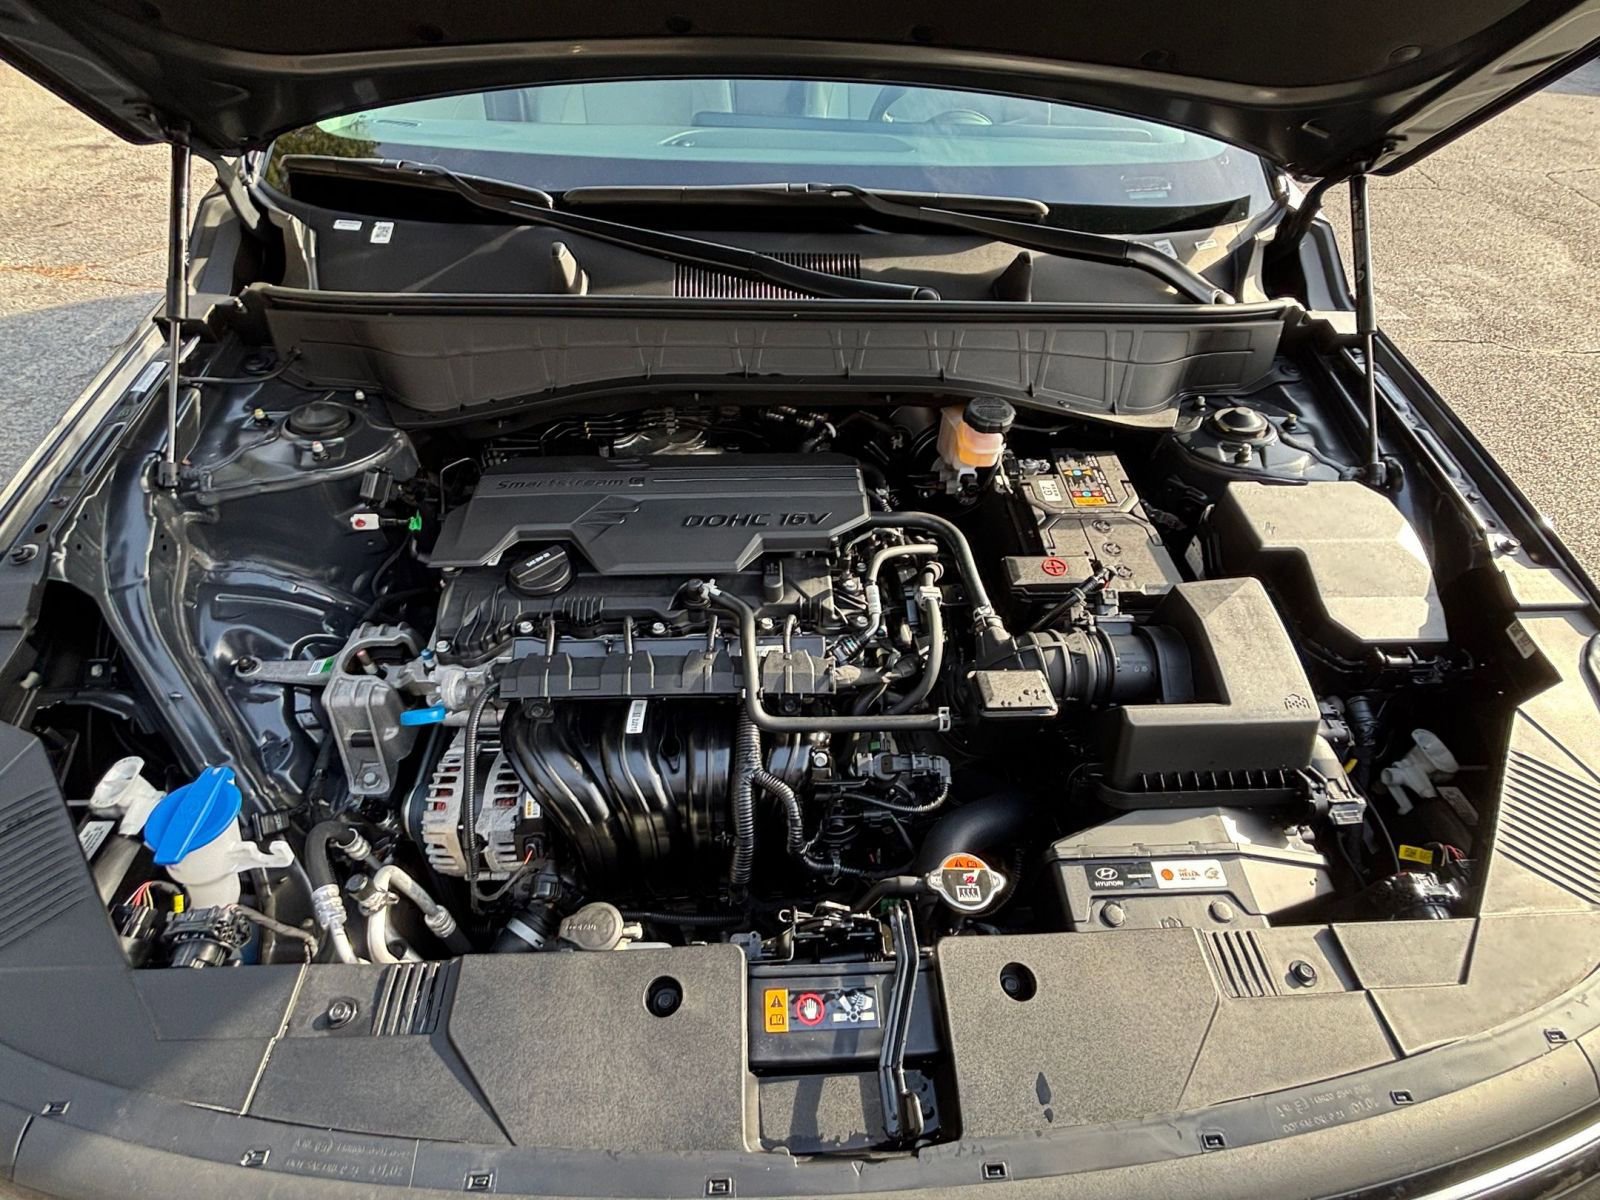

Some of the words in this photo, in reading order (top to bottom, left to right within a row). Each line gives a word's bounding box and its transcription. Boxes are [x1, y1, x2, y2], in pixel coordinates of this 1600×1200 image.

[497, 478, 624, 490] Smartstream
[681, 512, 772, 528] DOHC
[779, 511, 833, 526] 16V
